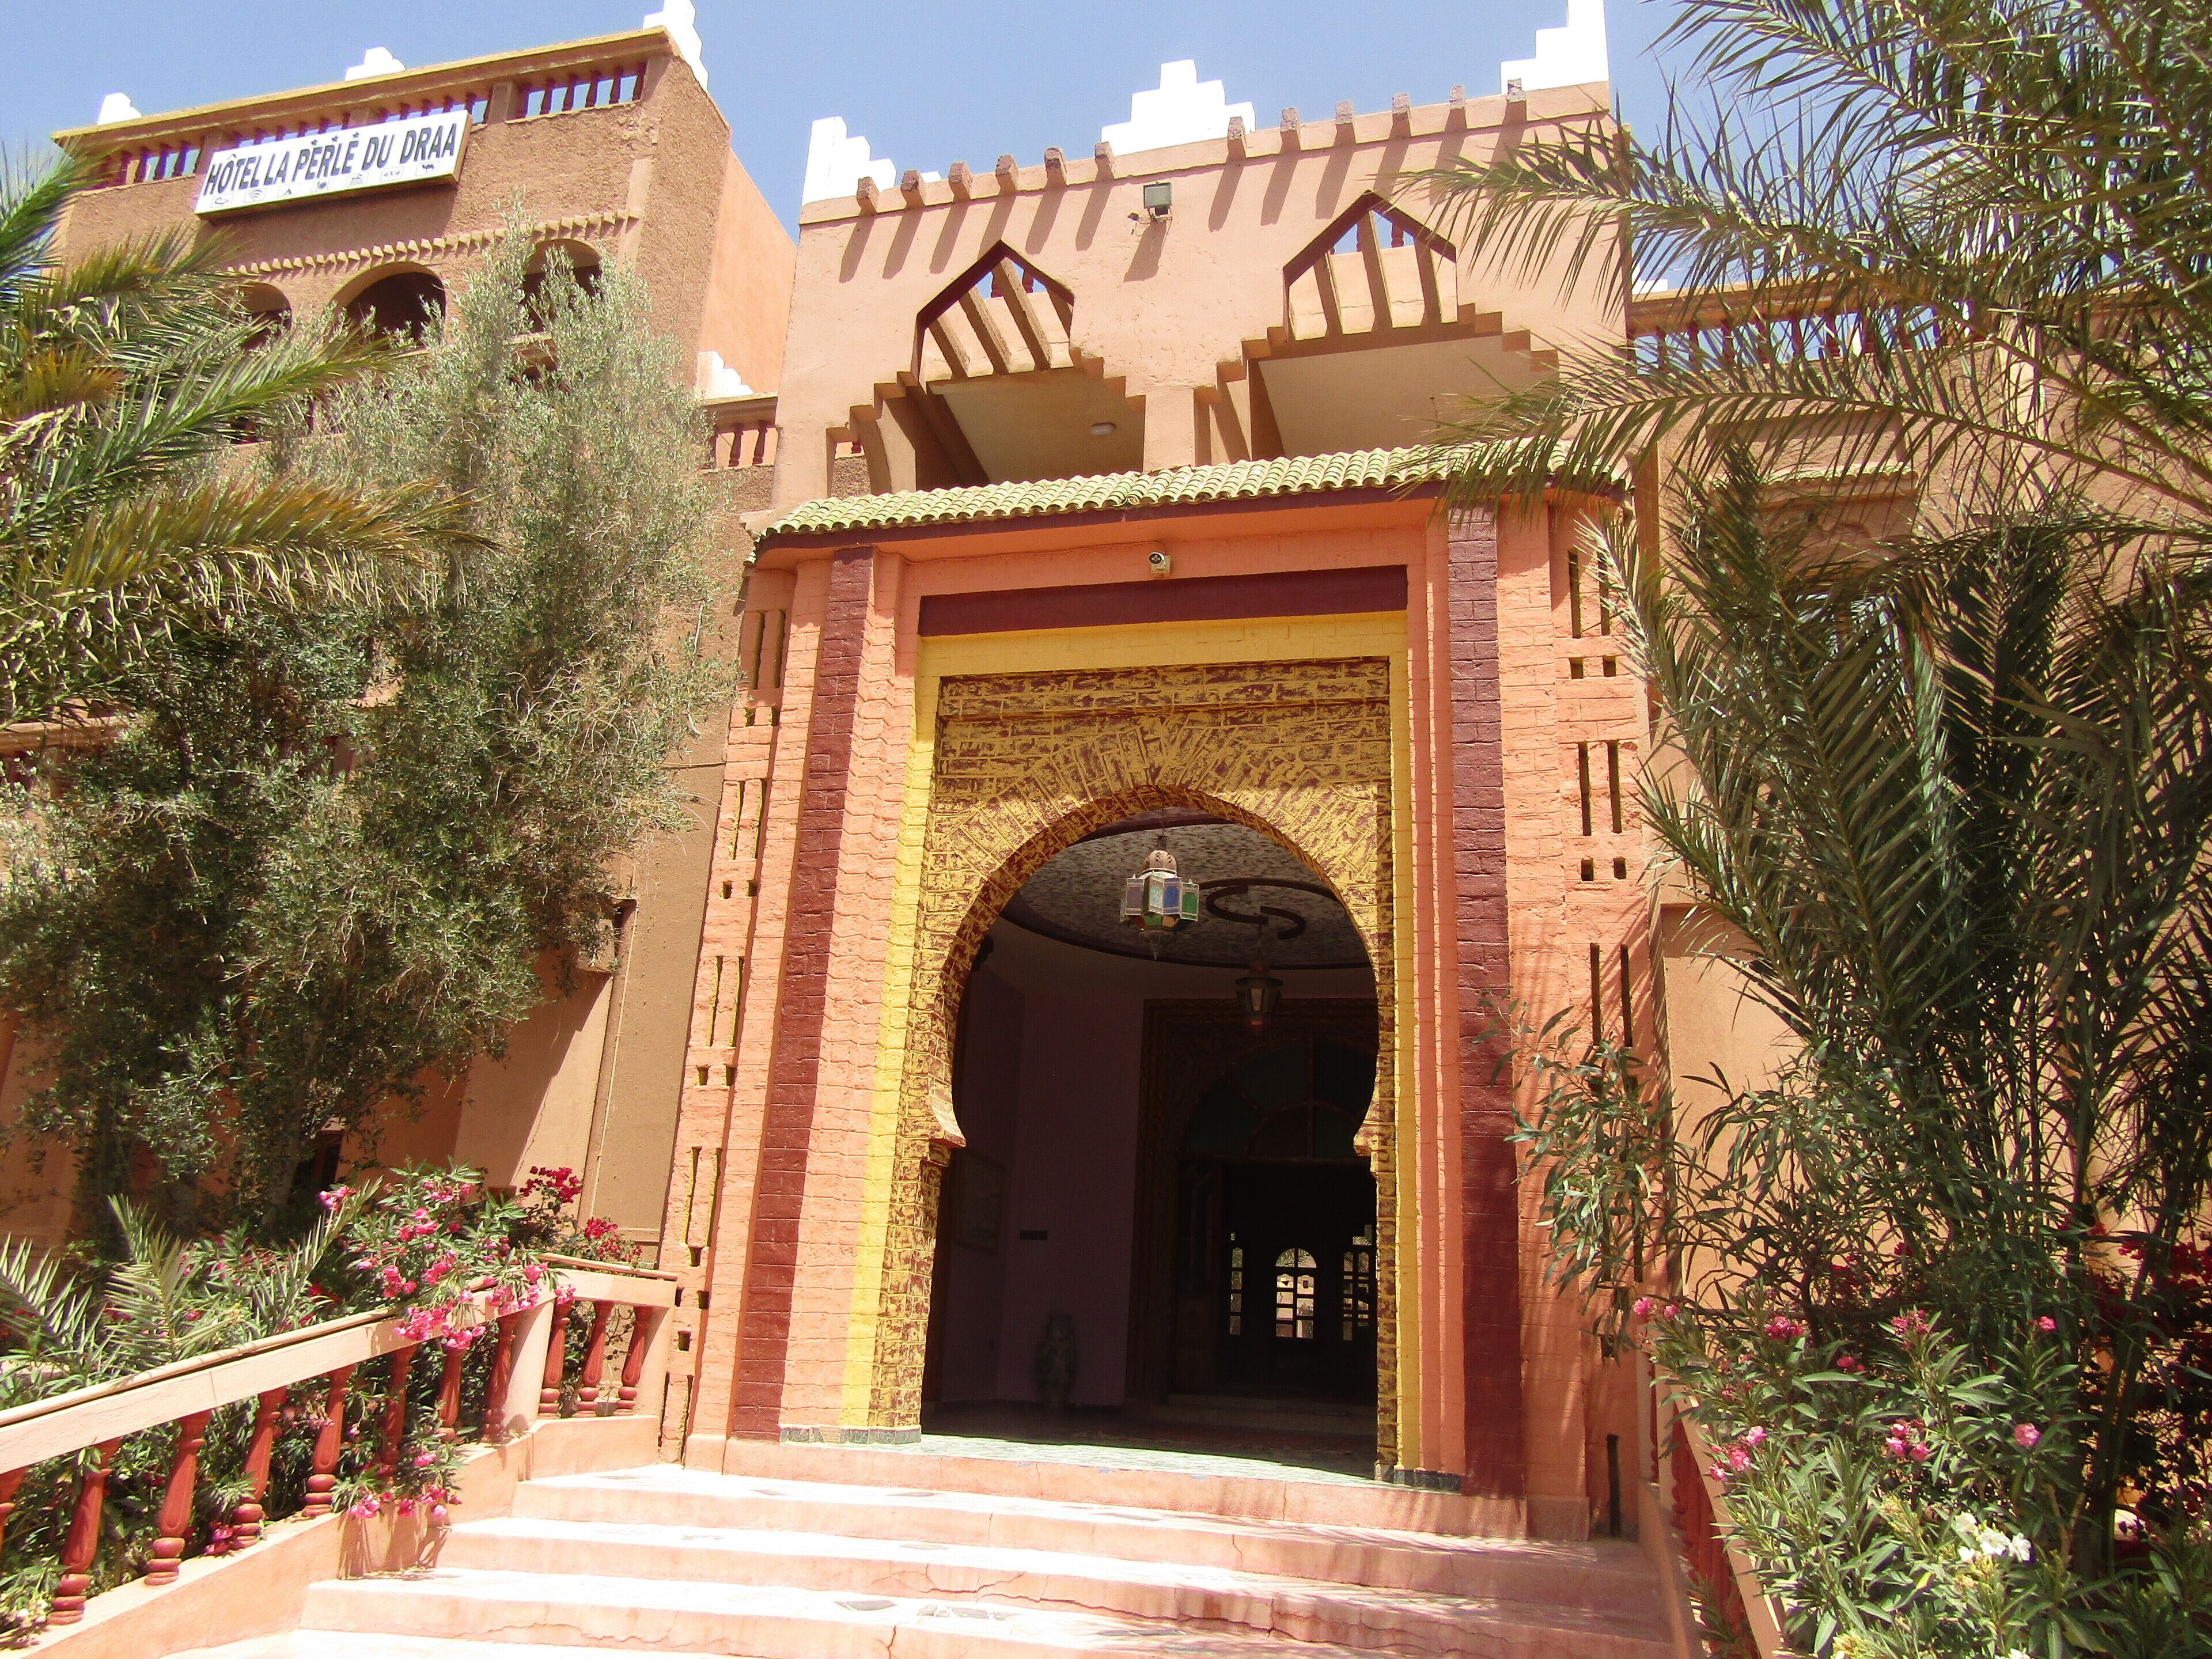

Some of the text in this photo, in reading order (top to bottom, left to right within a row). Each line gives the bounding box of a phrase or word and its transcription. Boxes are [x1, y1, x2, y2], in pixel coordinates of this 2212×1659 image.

[203, 153, 262, 196] HÔTEL
[263, 151, 290, 186] LA
[361, 134, 395, 171] DU
[399, 123, 457, 164] DRAA
